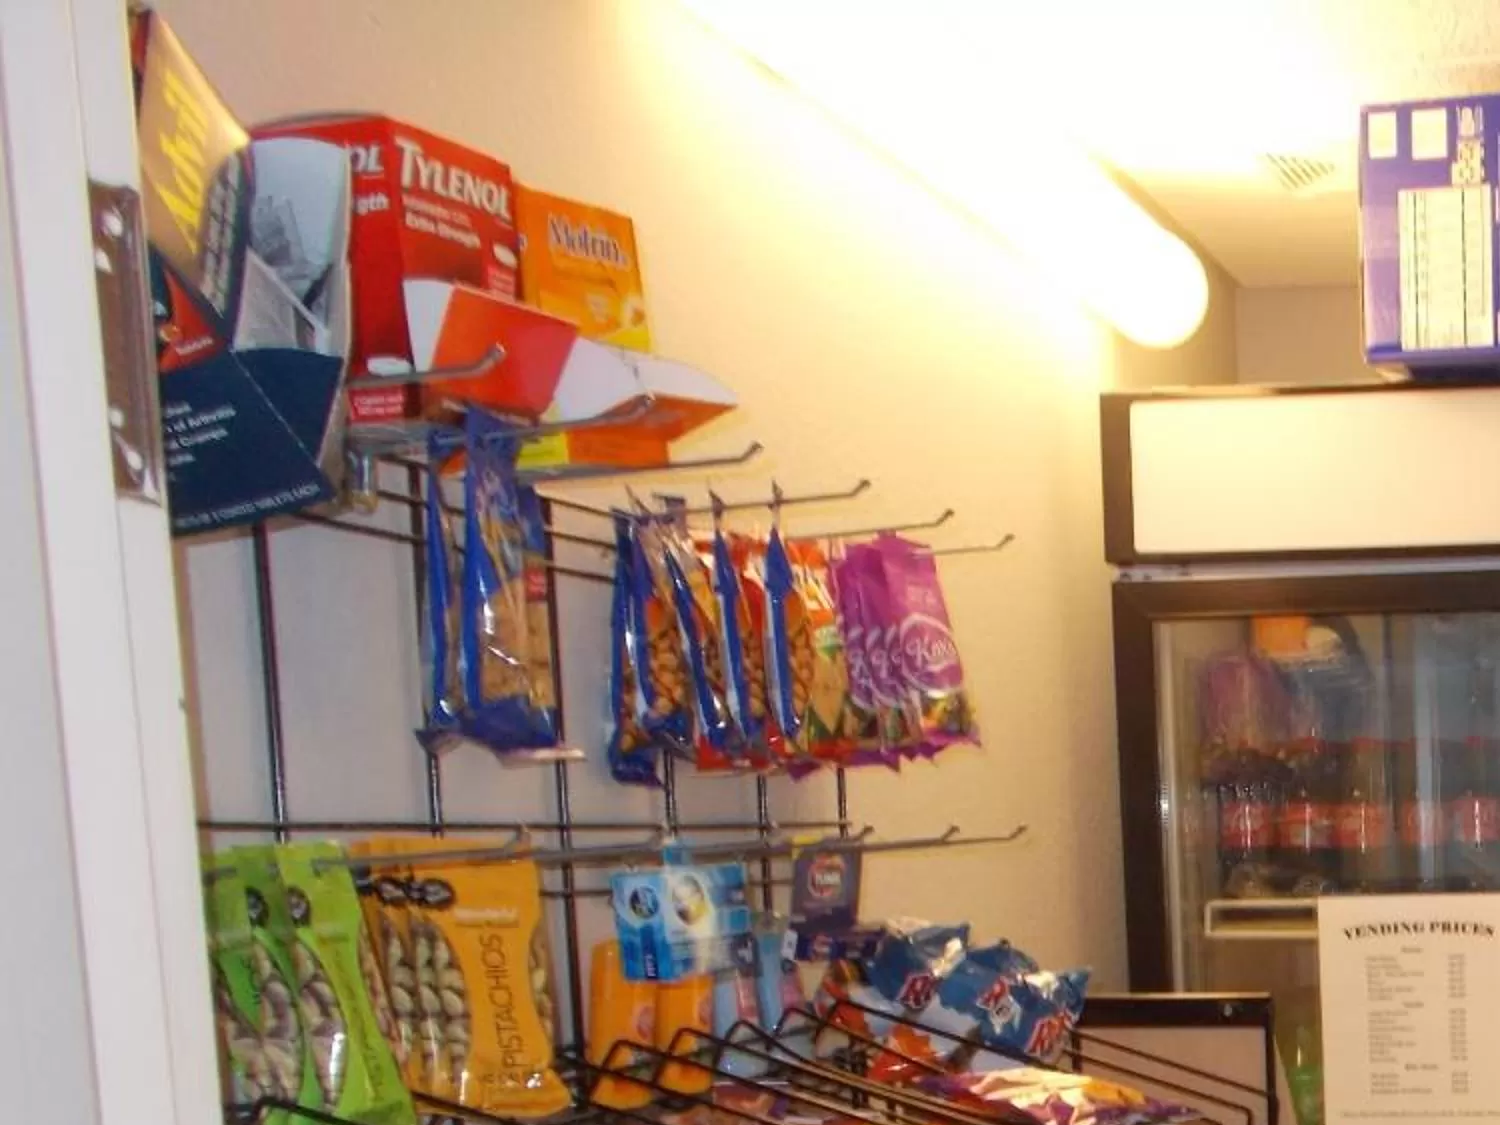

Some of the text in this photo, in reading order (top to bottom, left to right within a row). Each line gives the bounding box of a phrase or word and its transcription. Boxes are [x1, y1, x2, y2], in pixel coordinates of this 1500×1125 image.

[394, 133, 513, 222] TYLENOL
[1343, 920, 1495, 940] VENDING PRICES
[479, 932, 528, 1072] PISTACHIOS
